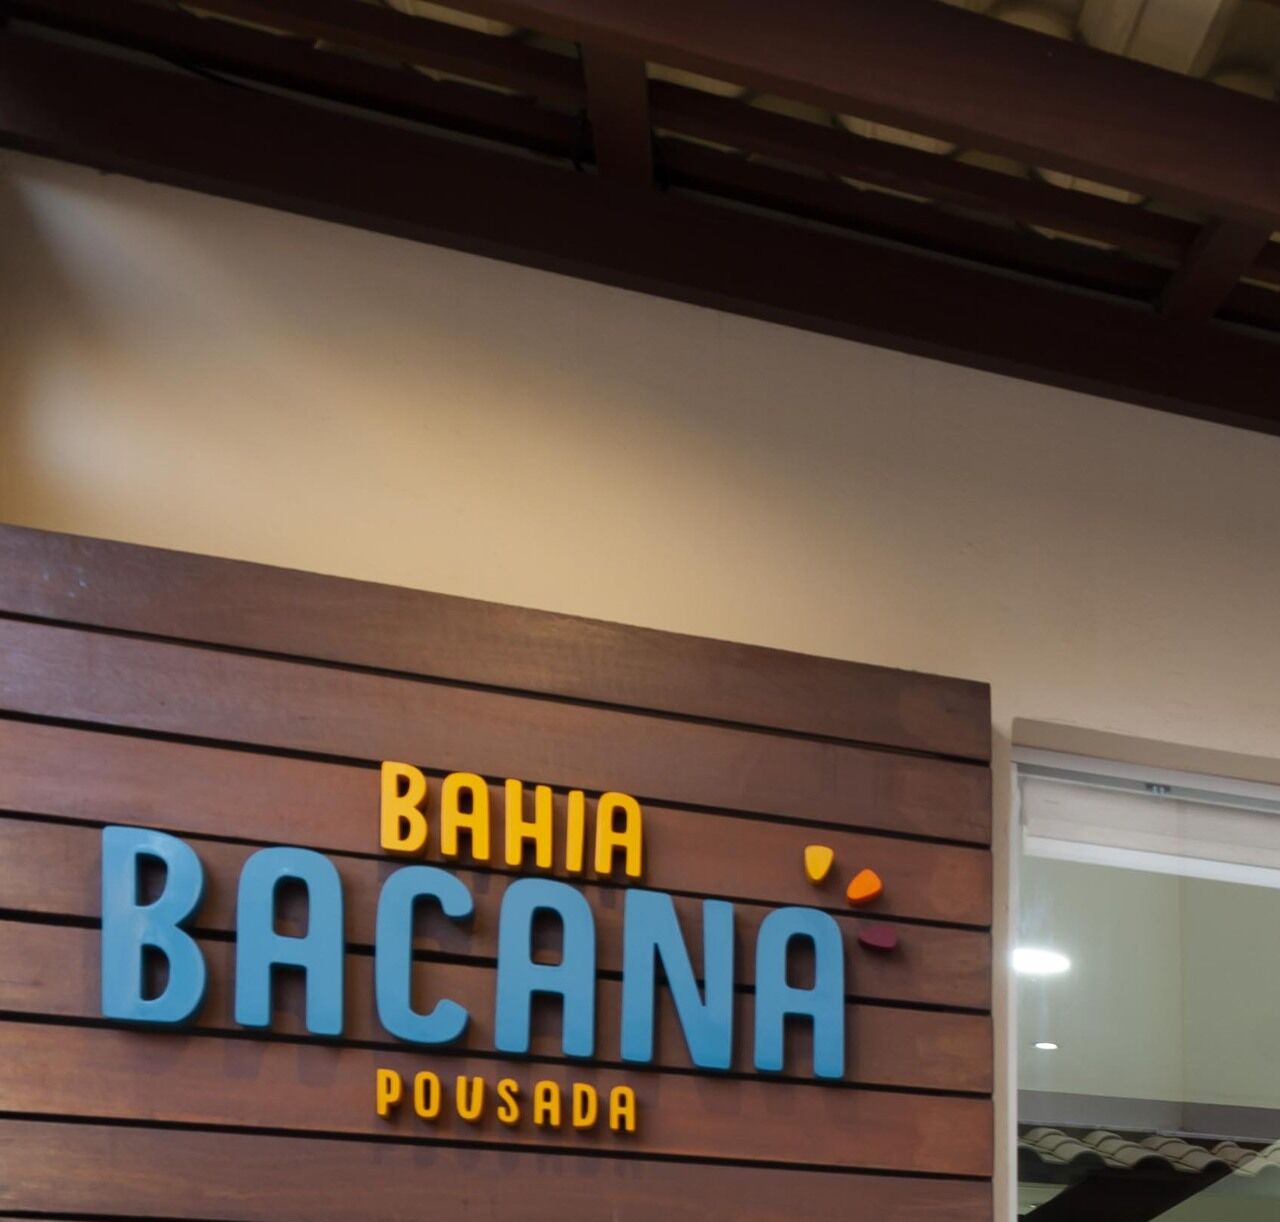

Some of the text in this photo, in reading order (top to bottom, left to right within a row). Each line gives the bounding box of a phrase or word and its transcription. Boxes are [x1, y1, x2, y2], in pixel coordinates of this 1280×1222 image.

[380, 760, 644, 878] BAHIA
[101, 824, 846, 1080] BACANA
[376, 1068, 637, 1133] POUSADA
